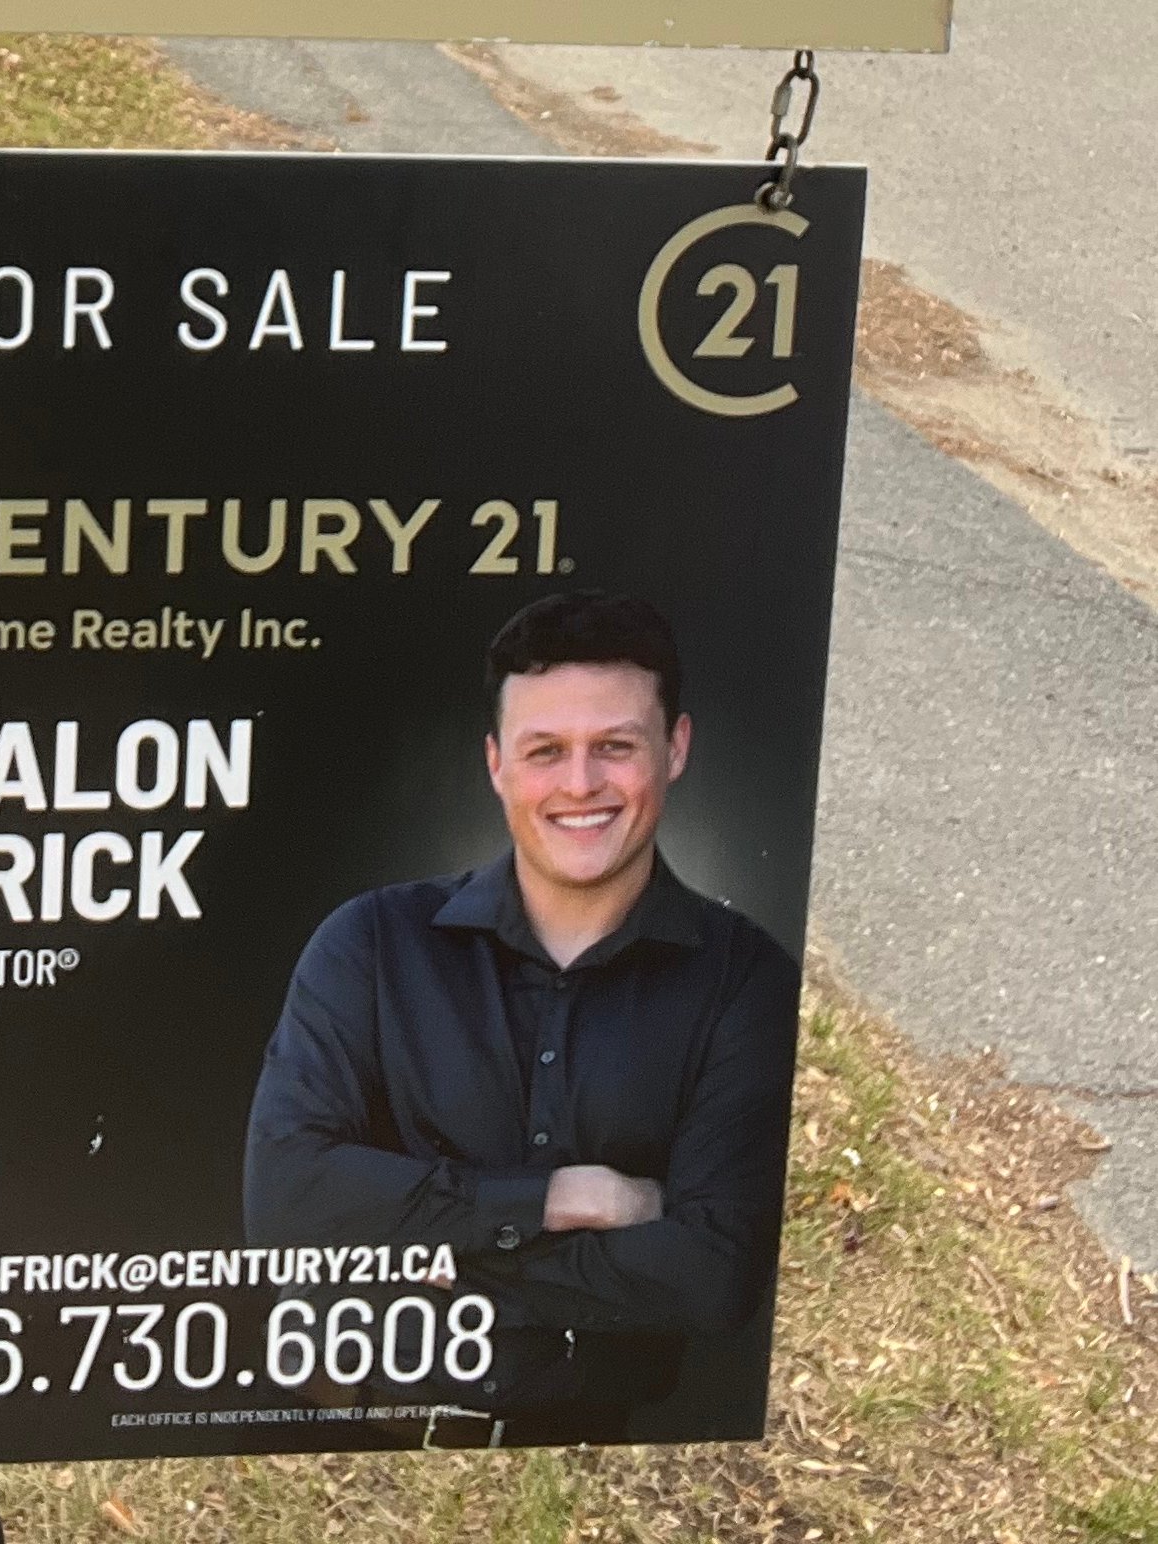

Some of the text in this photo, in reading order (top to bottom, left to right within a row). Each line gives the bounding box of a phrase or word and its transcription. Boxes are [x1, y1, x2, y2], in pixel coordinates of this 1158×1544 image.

[176, 266, 453, 352] SALE
[71, 606, 225, 660] Realty
[240, 607, 322, 649] Inc.
[111, 1413, 147, 1427] EACH
[148, 1411, 192, 1426] OFFICE
[195, 1411, 208, 1425] IS
[210, 1409, 315, 1424] INDEPENDENTLY
[316, 1407, 363, 1421] OWNED
[365, 1406, 393, 1420] AND
